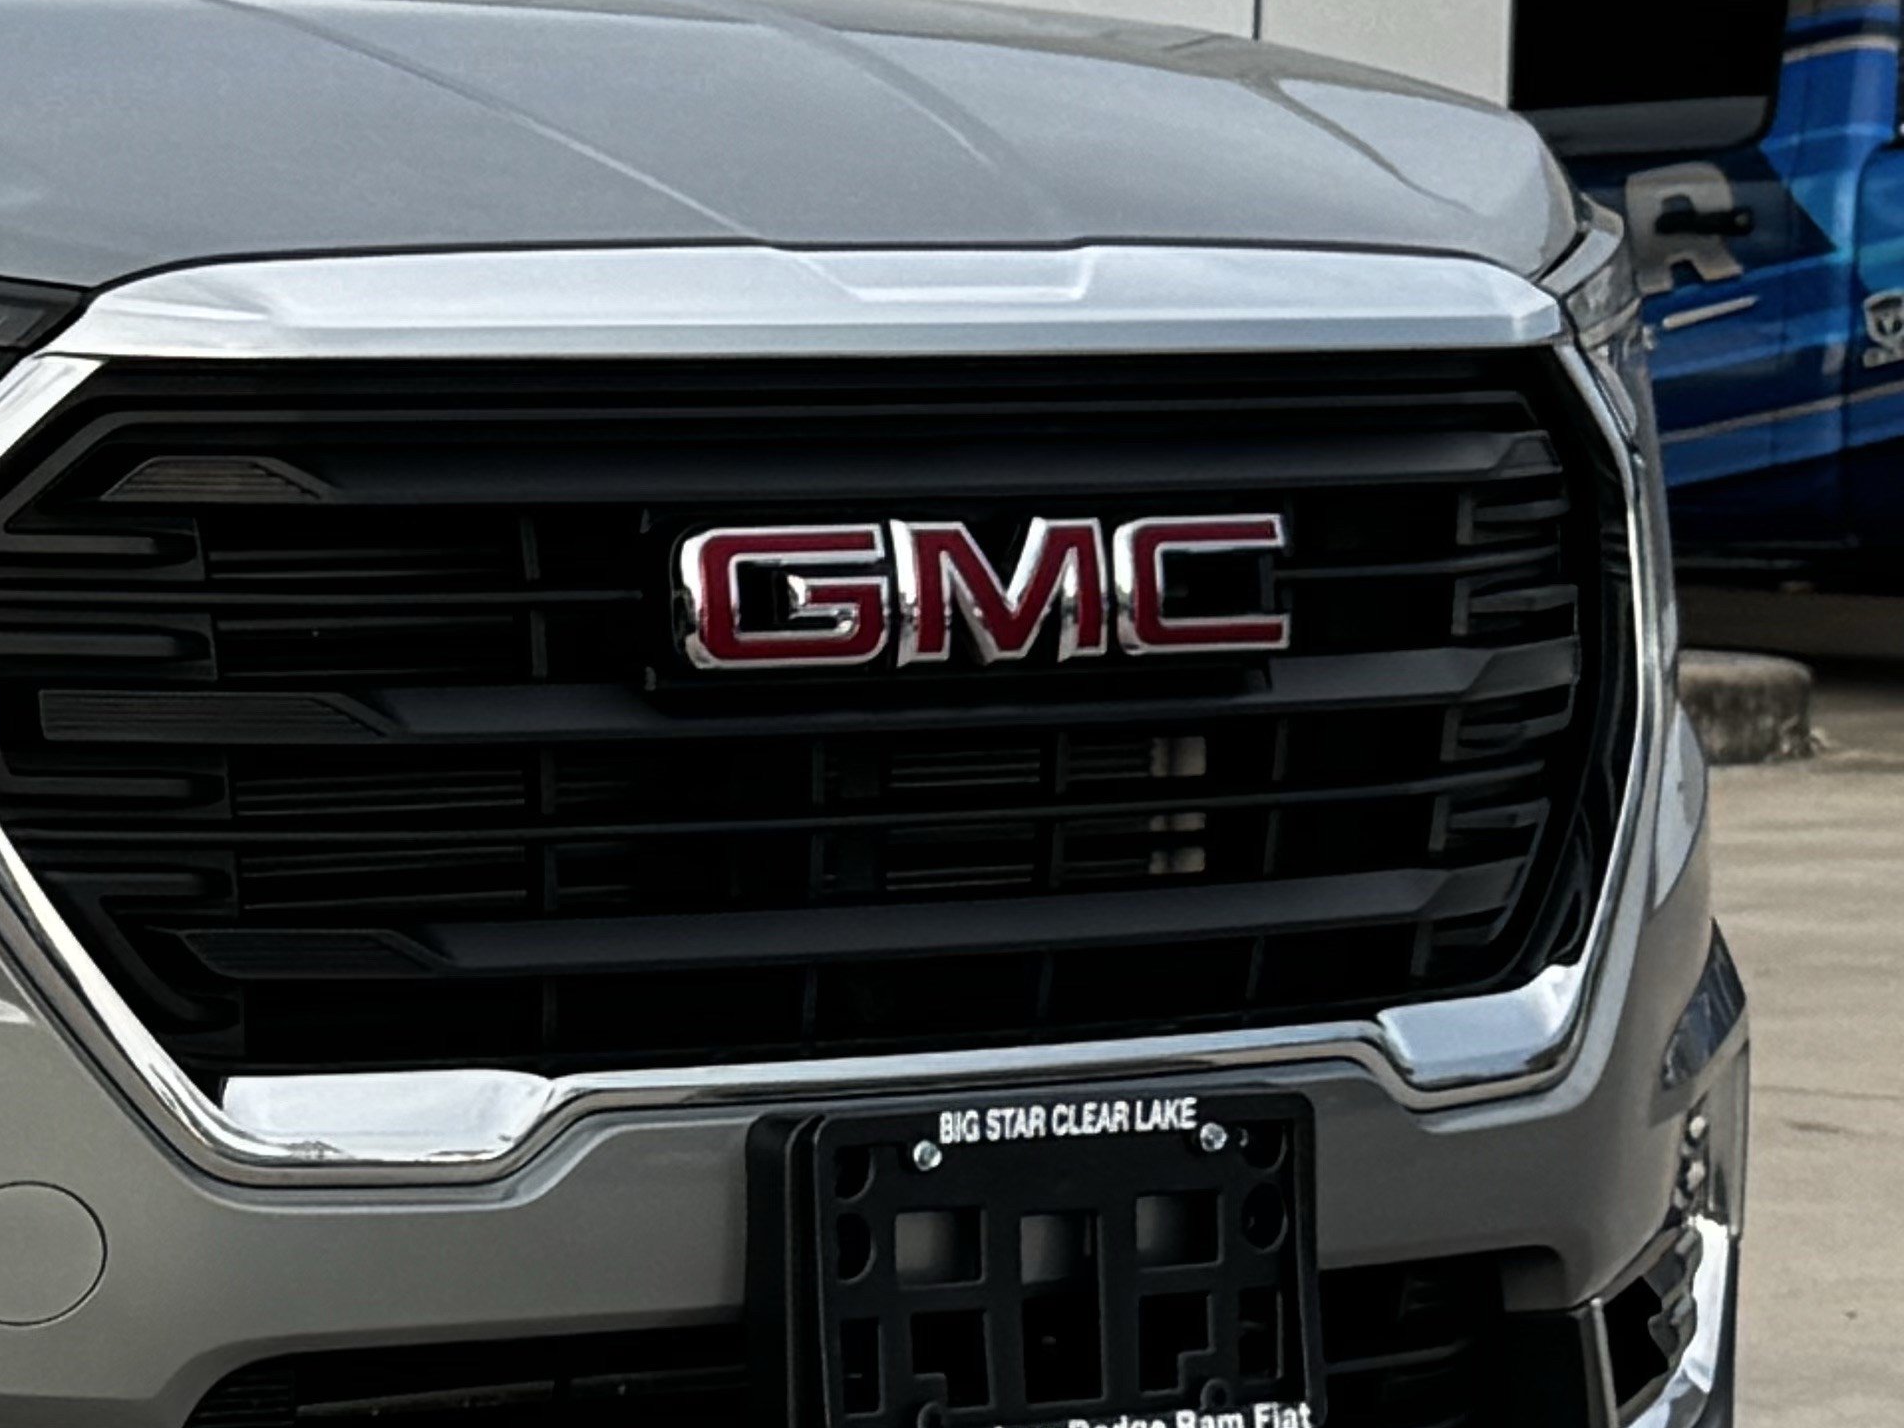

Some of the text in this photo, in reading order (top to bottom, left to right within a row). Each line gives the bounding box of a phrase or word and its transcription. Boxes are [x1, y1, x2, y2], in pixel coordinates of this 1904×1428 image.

[680, 513, 1291, 669] GMC
[940, 1097, 1197, 1144] BIG STAR CLEAR LAKE
